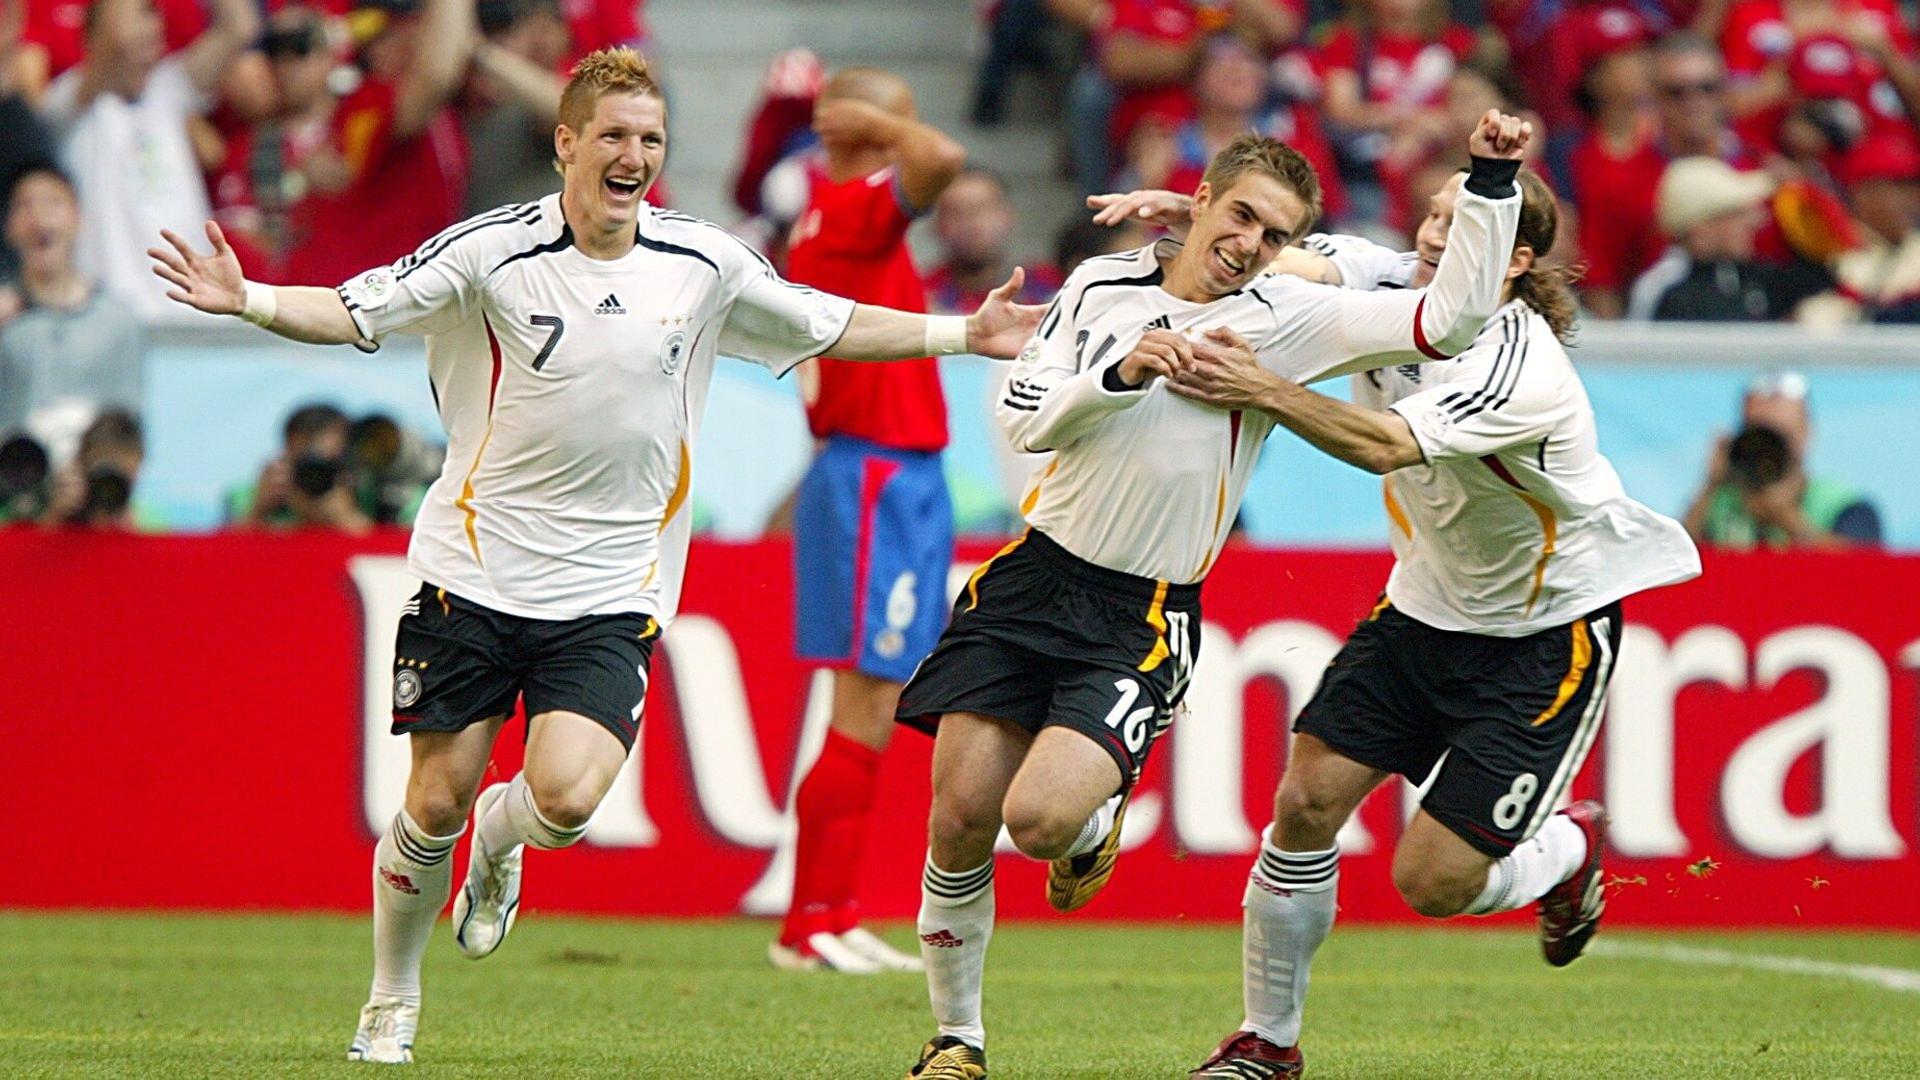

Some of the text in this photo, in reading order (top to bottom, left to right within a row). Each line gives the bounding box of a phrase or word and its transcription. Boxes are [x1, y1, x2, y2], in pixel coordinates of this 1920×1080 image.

[530, 315, 564, 372] 7
[886, 569, 918, 632] 6
[1103, 678, 1155, 754] 16
[1492, 772, 1539, 831] 8
